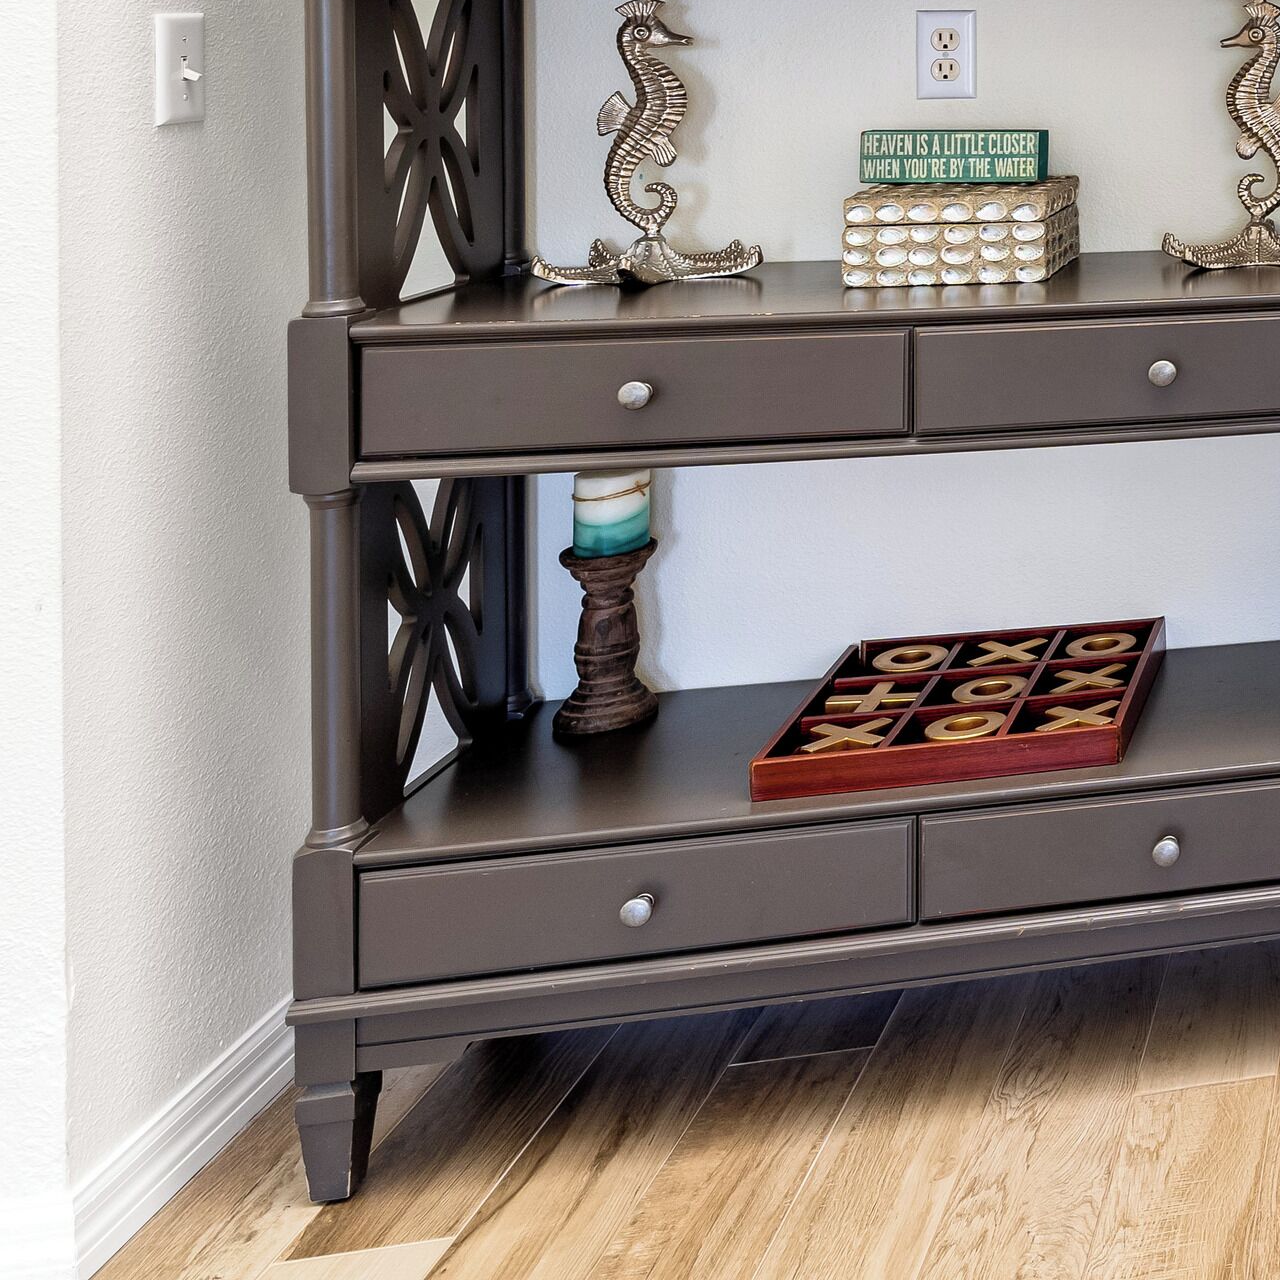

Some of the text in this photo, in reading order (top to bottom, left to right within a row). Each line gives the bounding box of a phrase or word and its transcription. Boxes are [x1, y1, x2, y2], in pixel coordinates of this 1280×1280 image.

[864, 133, 1036, 156] HEAVEN IS A LITTLE CLOSER
[863, 157, 1035, 179] WHEN YOU'RE BY THE WATER
